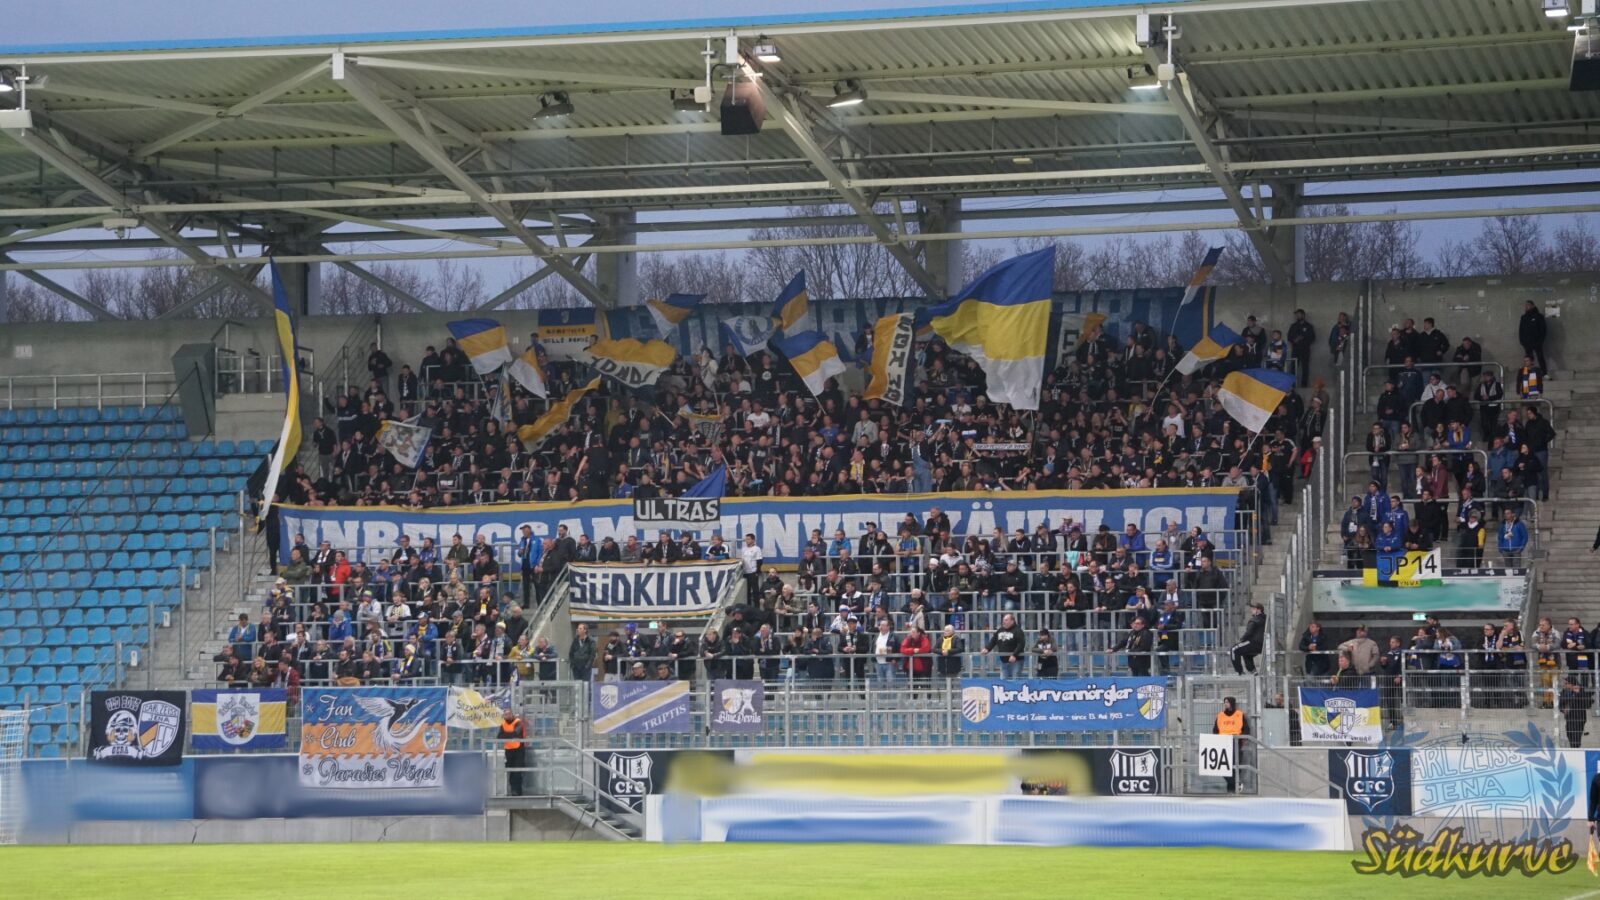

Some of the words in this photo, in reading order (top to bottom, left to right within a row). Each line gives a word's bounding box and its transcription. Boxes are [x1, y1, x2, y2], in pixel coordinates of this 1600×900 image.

[636, 499, 718, 520] ULTRAS
[993, 683, 1132, 706] Nordkurvennörgler
[319, 694, 353, 721] Fan
[642, 704, 687, 731] TRIPTIS
[715, 711, 740, 724] Blue
[738, 711, 761, 723] Devils
[319, 726, 356, 749] Club
[1201, 747, 1230, 770] 19A
[318, 757, 386, 784] Paradies
[387, 759, 436, 785] Vögel
[615, 781, 646, 794] CFC
[1118, 780, 1150, 792] CFC
[1353, 780, 1386, 793] CFC
